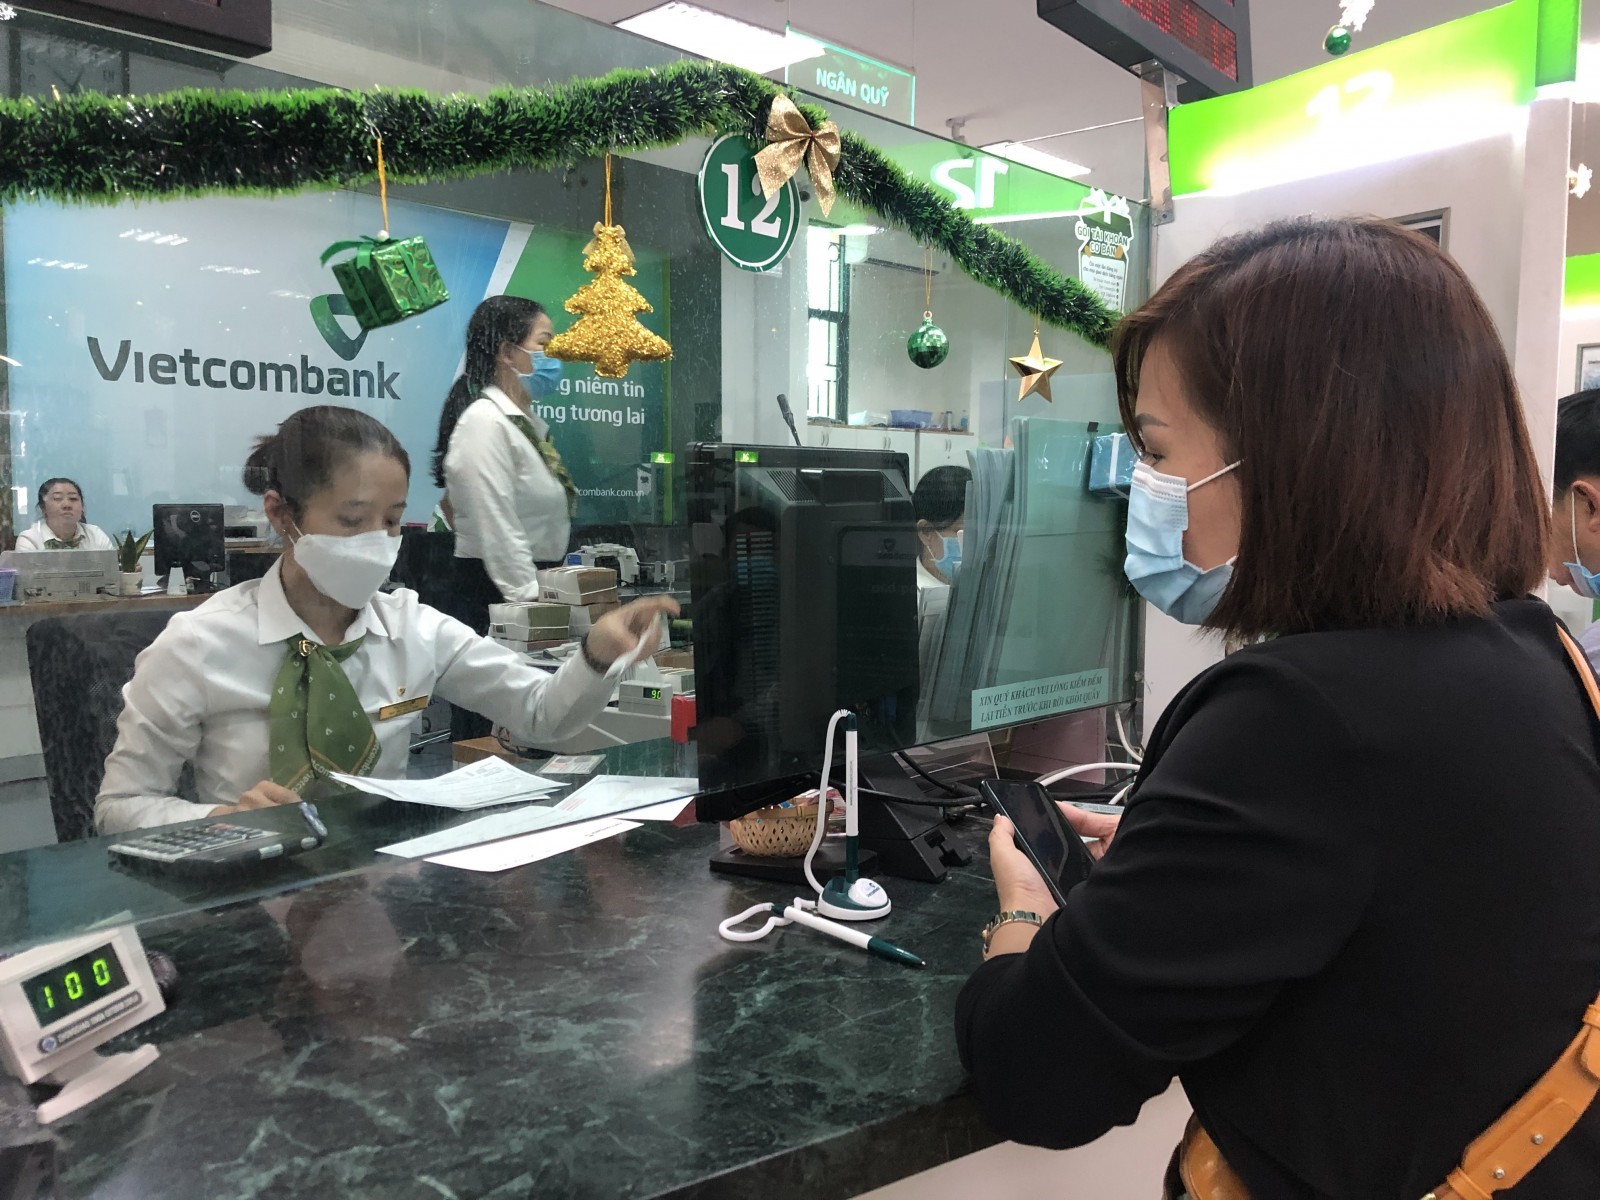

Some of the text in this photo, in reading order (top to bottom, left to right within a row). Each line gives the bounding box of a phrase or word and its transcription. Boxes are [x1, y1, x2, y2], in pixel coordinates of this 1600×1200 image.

[816, 68, 889, 107] NGÂN QUỸ
[720, 163, 782, 239] 12
[86, 335, 402, 400] Vietcombank
[623, 380, 645, 398] tin
[626, 406, 645, 425] lai
[577, 488, 645, 497] combank.com.vn
[979, 696, 994, 707] XIN
[1010, 687, 1036, 701] KHÁCH
[1039, 700, 1052, 710] KHI
[44, 958, 111, 1009] 100
